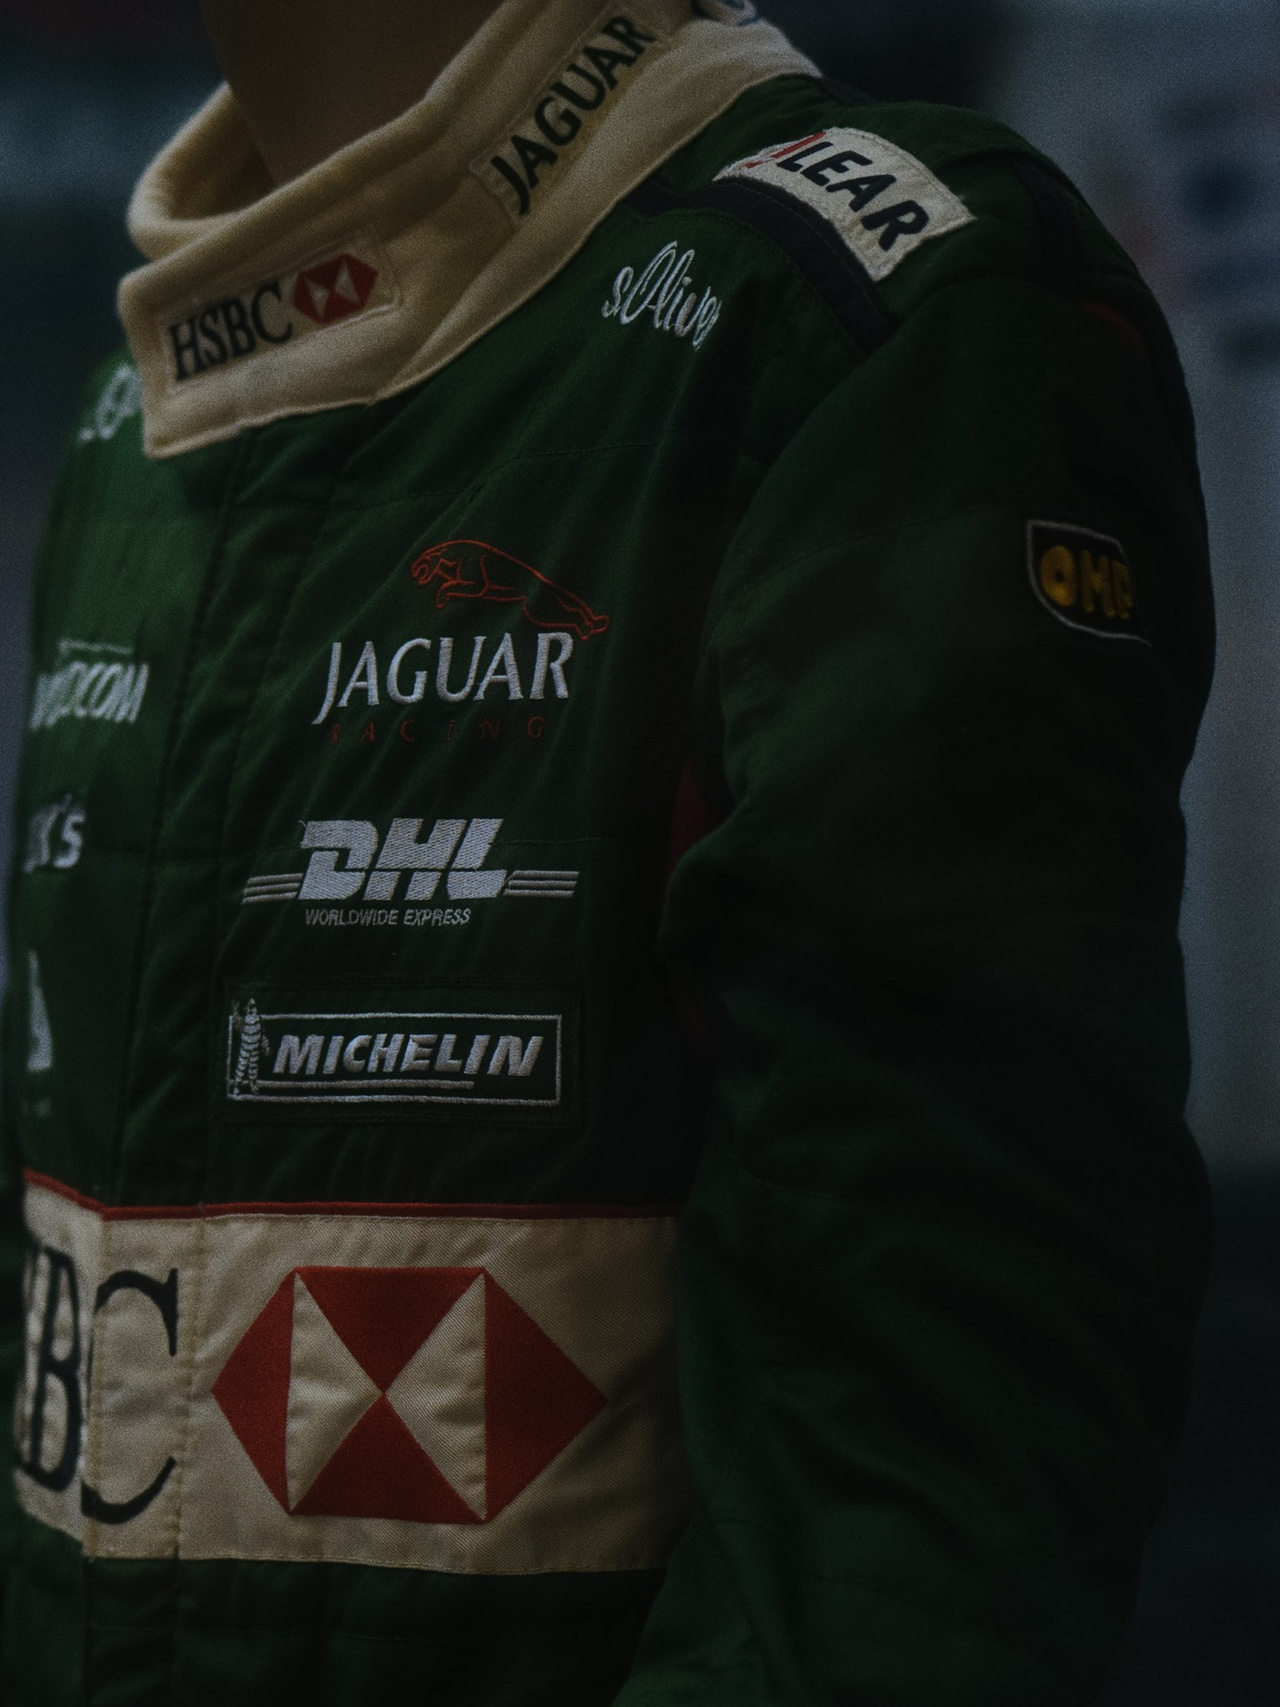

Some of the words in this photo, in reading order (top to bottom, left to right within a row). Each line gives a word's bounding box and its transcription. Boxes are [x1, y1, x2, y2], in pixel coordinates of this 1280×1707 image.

[490, 12, 657, 214] JAGUAR
[776, 140, 930, 252] LEAR
[166, 281, 294, 381] HSBC
[311, 631, 575, 725] JAGUAR
[297, 817, 508, 901] DHL
[304, 908, 398, 926] WORLDWIDE
[403, 907, 472, 926] EXPRESS
[272, 1033, 545, 1077] MICHELIN
[17, 1246, 179, 1525] BC
